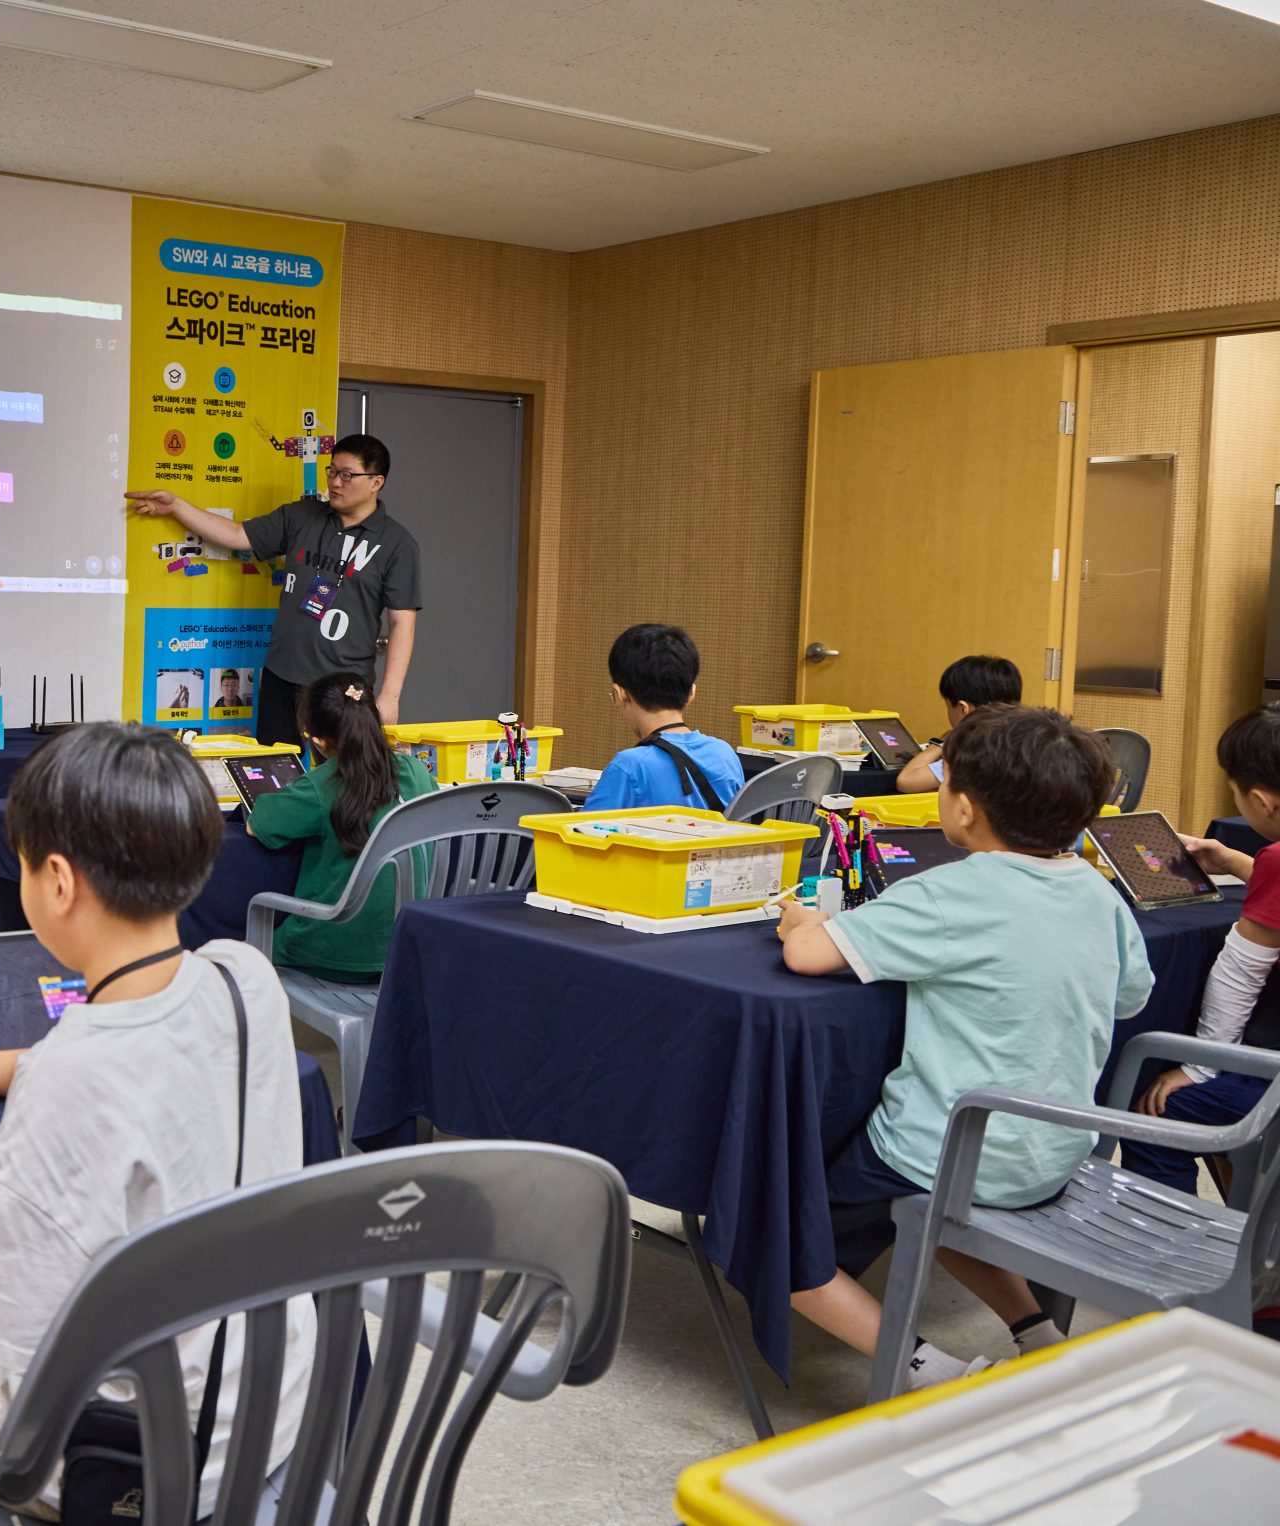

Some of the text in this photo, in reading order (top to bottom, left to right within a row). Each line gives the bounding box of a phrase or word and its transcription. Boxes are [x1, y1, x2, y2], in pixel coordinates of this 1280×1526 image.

[172, 247, 313, 278] SW와 AI 교육을 하나로
[227, 293, 316, 320] Education
[259, 326, 316, 355] 프라임
[153, 405, 173, 413] STEAM
[220, 409, 231, 417] 구성
[232, 410, 243, 418] 요소
[340, 534, 381, 571] W
[284, 572, 297, 593] R
[203, 624, 238, 633] Education
[212, 640, 231, 649] 파이썬
[233, 640, 252, 649] 기반의
